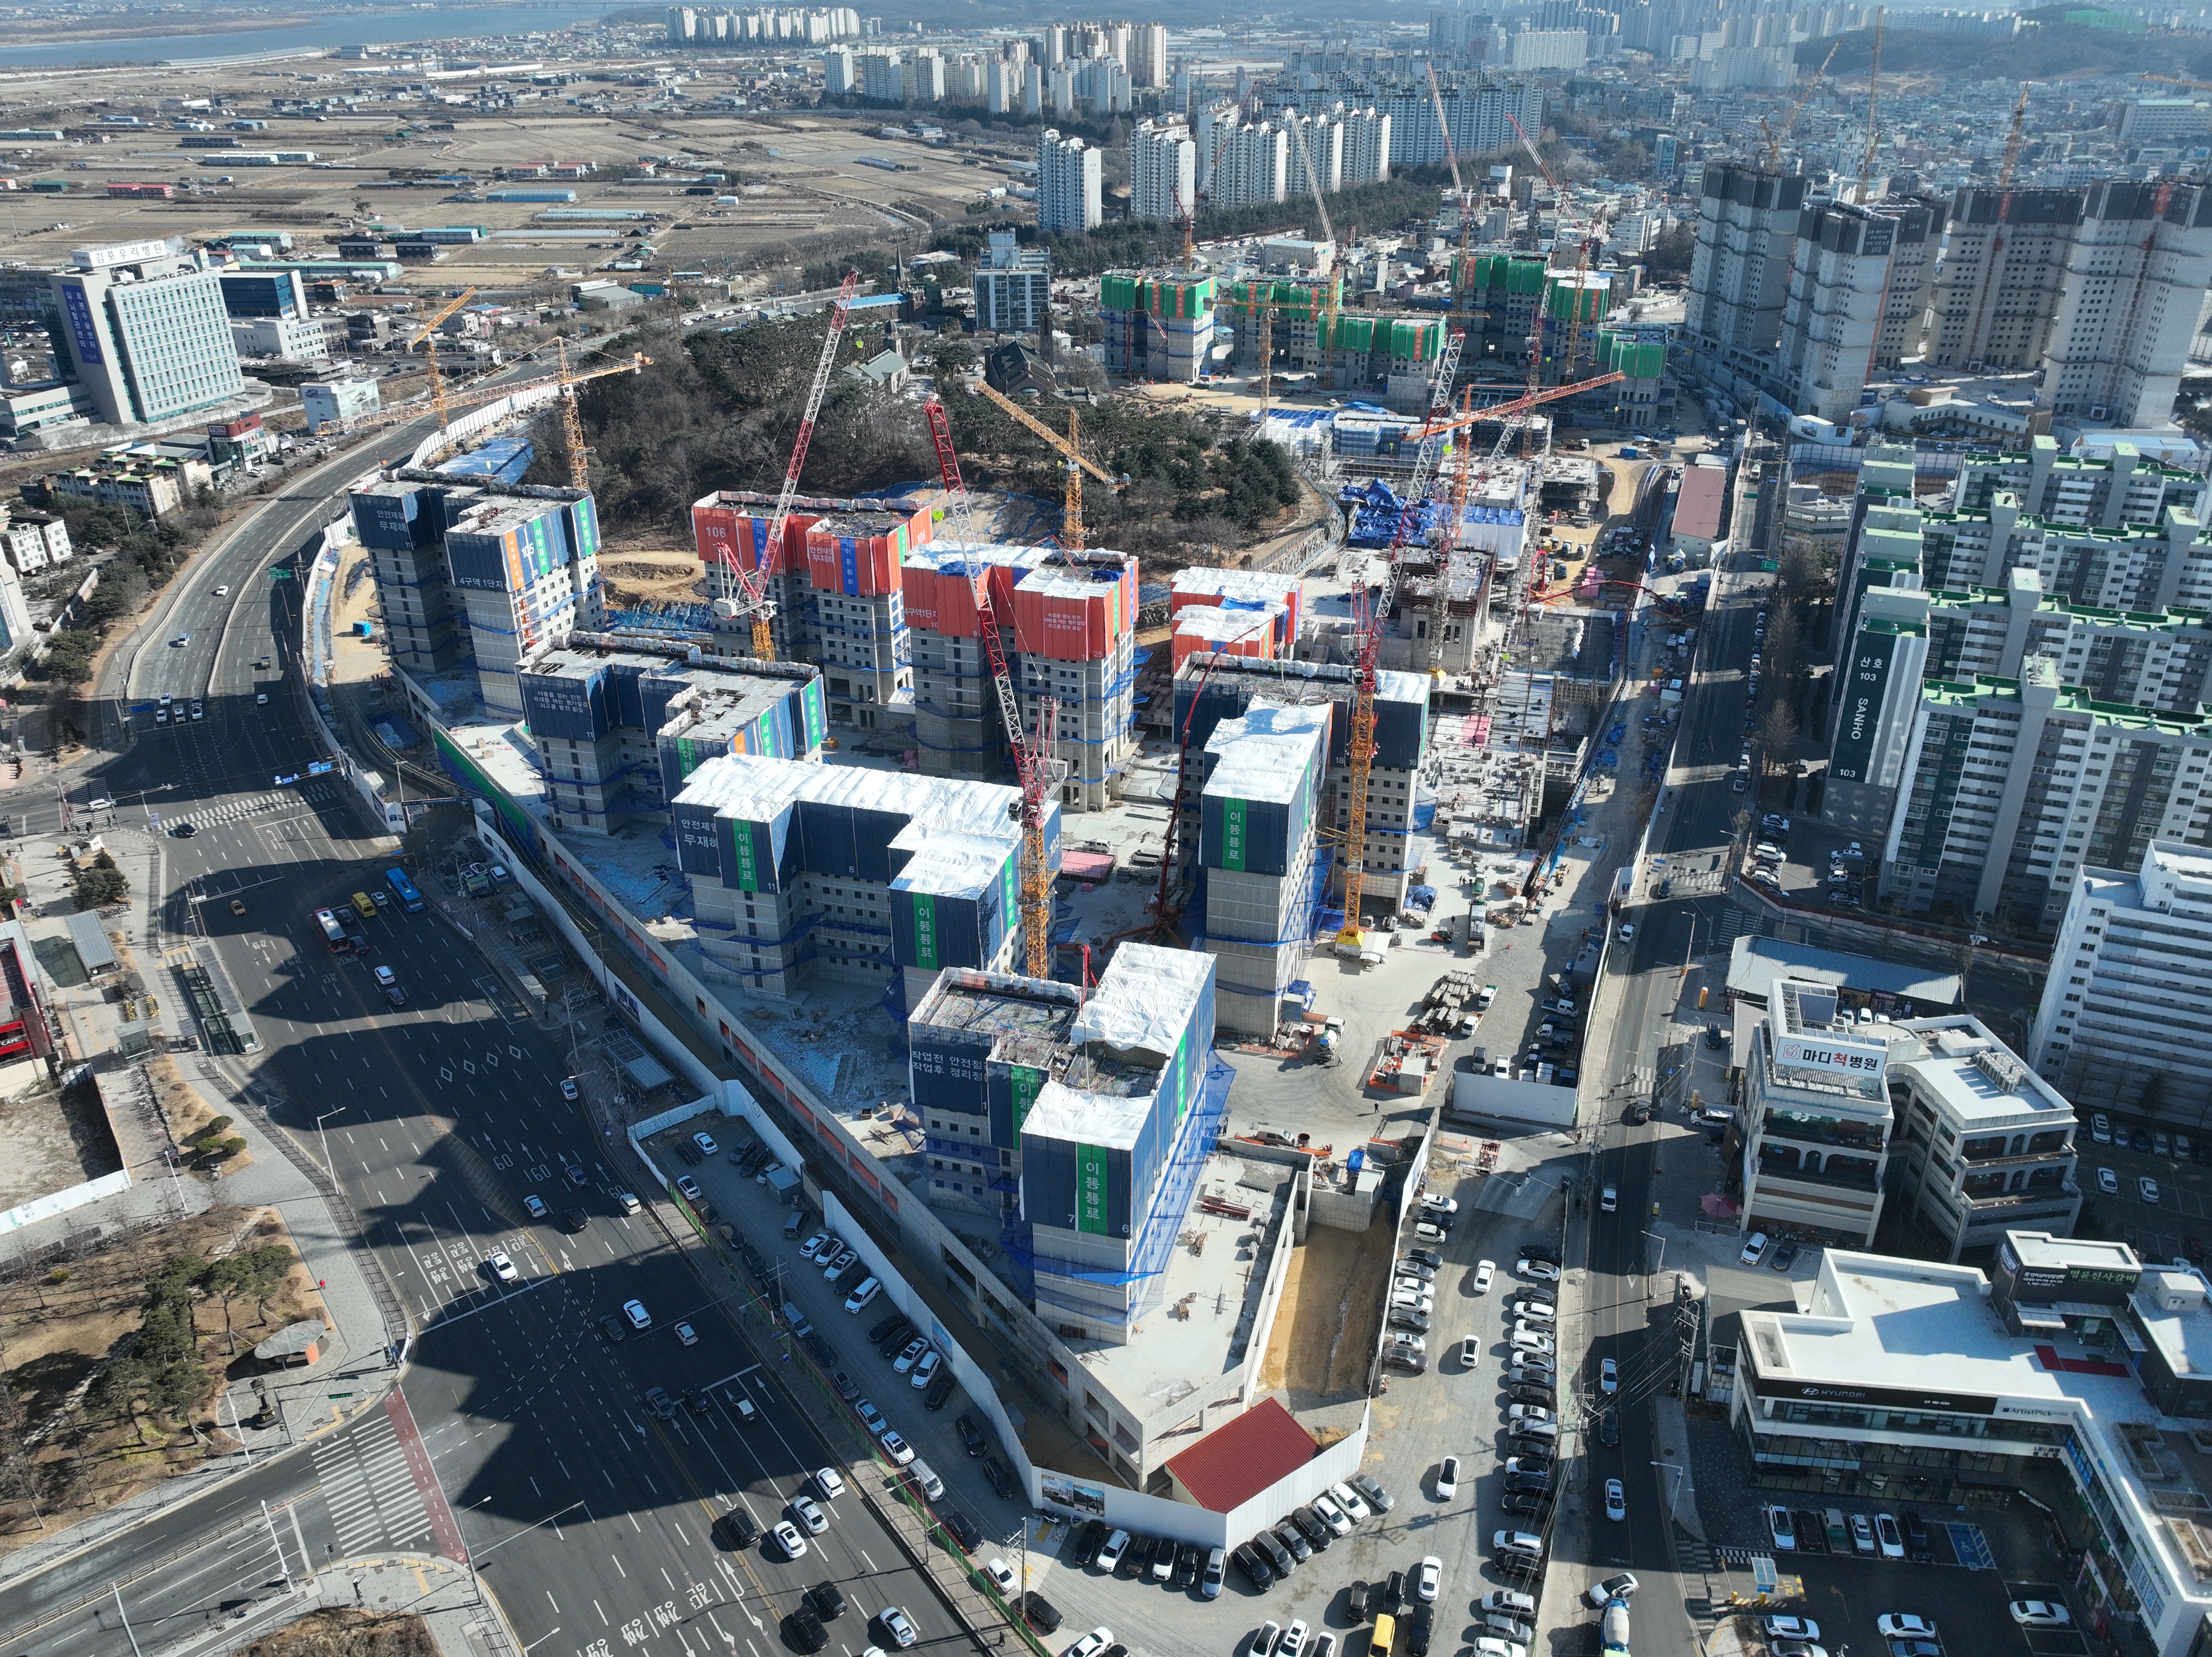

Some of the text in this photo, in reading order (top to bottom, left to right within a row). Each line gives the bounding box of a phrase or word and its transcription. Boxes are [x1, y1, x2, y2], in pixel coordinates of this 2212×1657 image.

[94, 243, 163, 263] 김포우리병원
[76, 291, 97, 349] 로봇수술센터
[377, 509, 405, 520] 안전제일
[380, 521, 408, 533] 무재해
[581, 511, 591, 546] 이동통로
[706, 527, 726, 538] 106
[916, 530, 926, 543] 106
[521, 542, 534, 559] 105
[535, 529, 546, 565] 이동통로
[845, 548, 854, 586] 이동통로
[459, 576, 503, 589] 4구역 1단지
[1860, 672, 1877, 681] 103
[810, 693, 818, 737] 이동통로
[1851, 697, 1869, 740] SANHO
[1840, 768, 1856, 778] 103
[1229, 812, 1240, 860] 이동통로
[1049, 834, 1059, 857] 103
[739, 833, 753, 880] 이동통로
[791, 865, 796, 874] 10
[918, 908, 932, 958] 이동통로
[1, 1038, 19, 1046] CAFE
[911, 1050, 944, 1064] 작업전
[1802, 1048, 1878, 1071] 마디척병원
[912, 1061, 945, 1076] 작업후
[494, 1154, 514, 1171] 60
[608, 1185, 626, 1199] 60
[1085, 1162, 1100, 1220] 이동통로
[1067, 1213, 1075, 1223] 7
[1122, 1224, 1129, 1233] 6
[448, 1242, 469, 1258] 통진
[421, 1252, 442, 1269] 통진
[457, 1257, 478, 1274] 강화
[430, 1267, 451, 1284] 강화
[1821, 1390, 1866, 1399] HYUNDAI
[2010, 1408, 2052, 1417] ArtistPick
[1783, 1579, 1795, 1597] OUT
[655, 1600, 682, 1629] 강화
[621, 1618, 649, 1647] 강화
